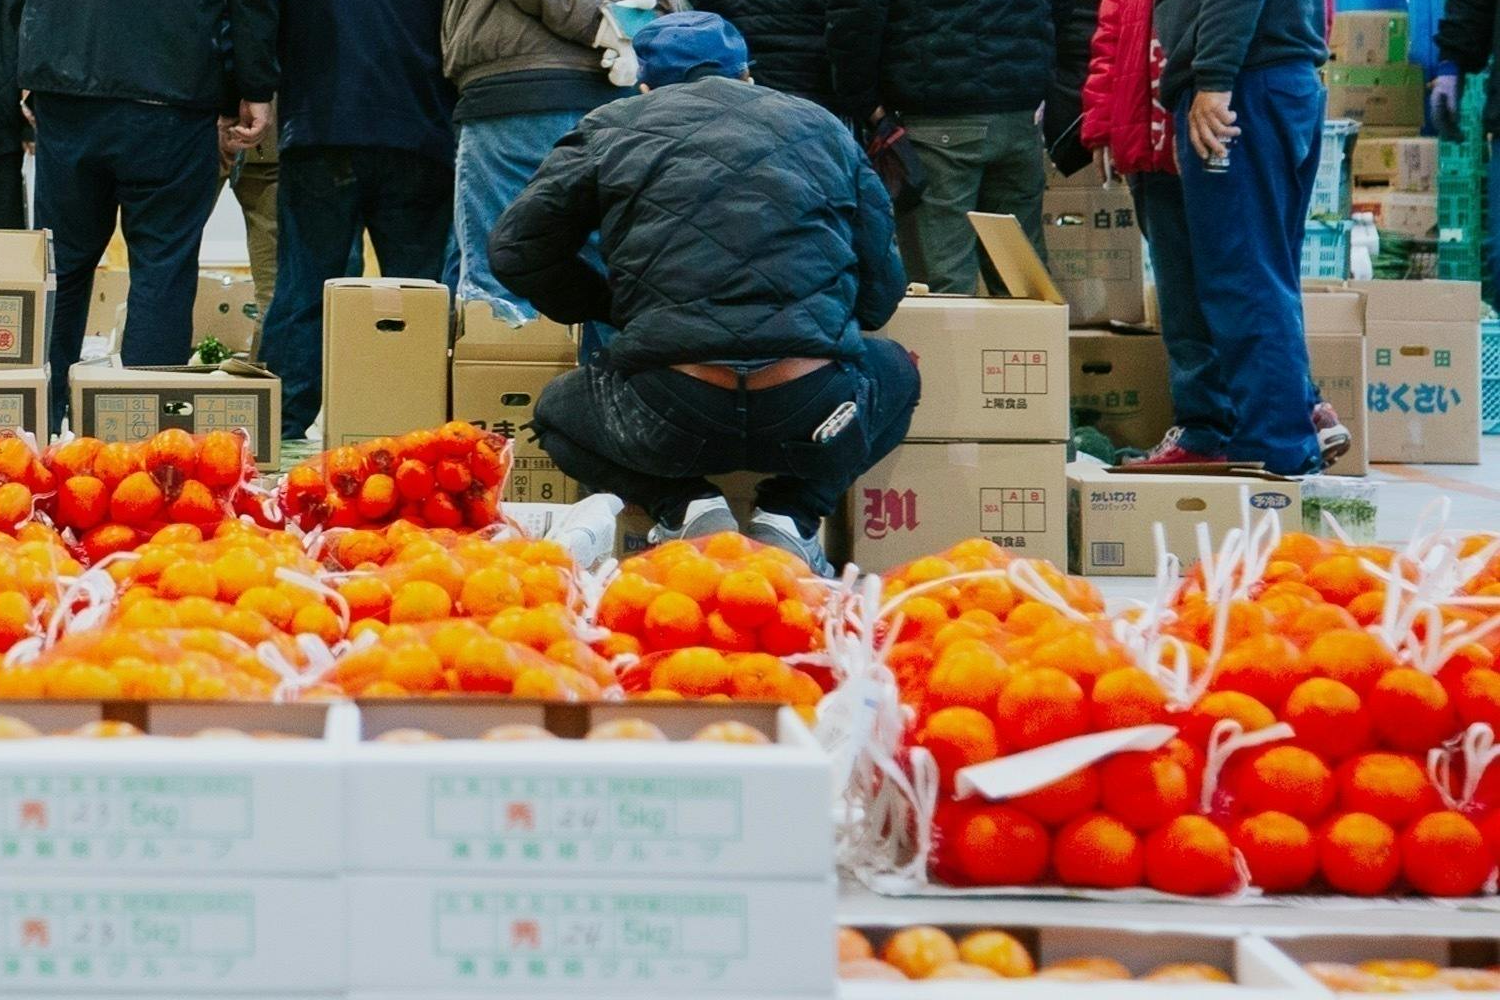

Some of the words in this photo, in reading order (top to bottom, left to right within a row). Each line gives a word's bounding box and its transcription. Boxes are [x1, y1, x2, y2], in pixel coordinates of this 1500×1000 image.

[1094, 208, 1134, 229] 白菜
[1011, 354, 1020, 362] A
[1032, 353, 1041, 363] B
[1367, 382, 1462, 414] はくさい
[514, 475, 528, 486] 20
[541, 482, 553, 500] 8
[1009, 491, 1018, 500] A
[1031, 491, 1040, 501] B
[1090, 491, 1136, 503] かいわれ
[863, 487, 920, 540] M
[984, 536, 1026, 548] 陽食品
